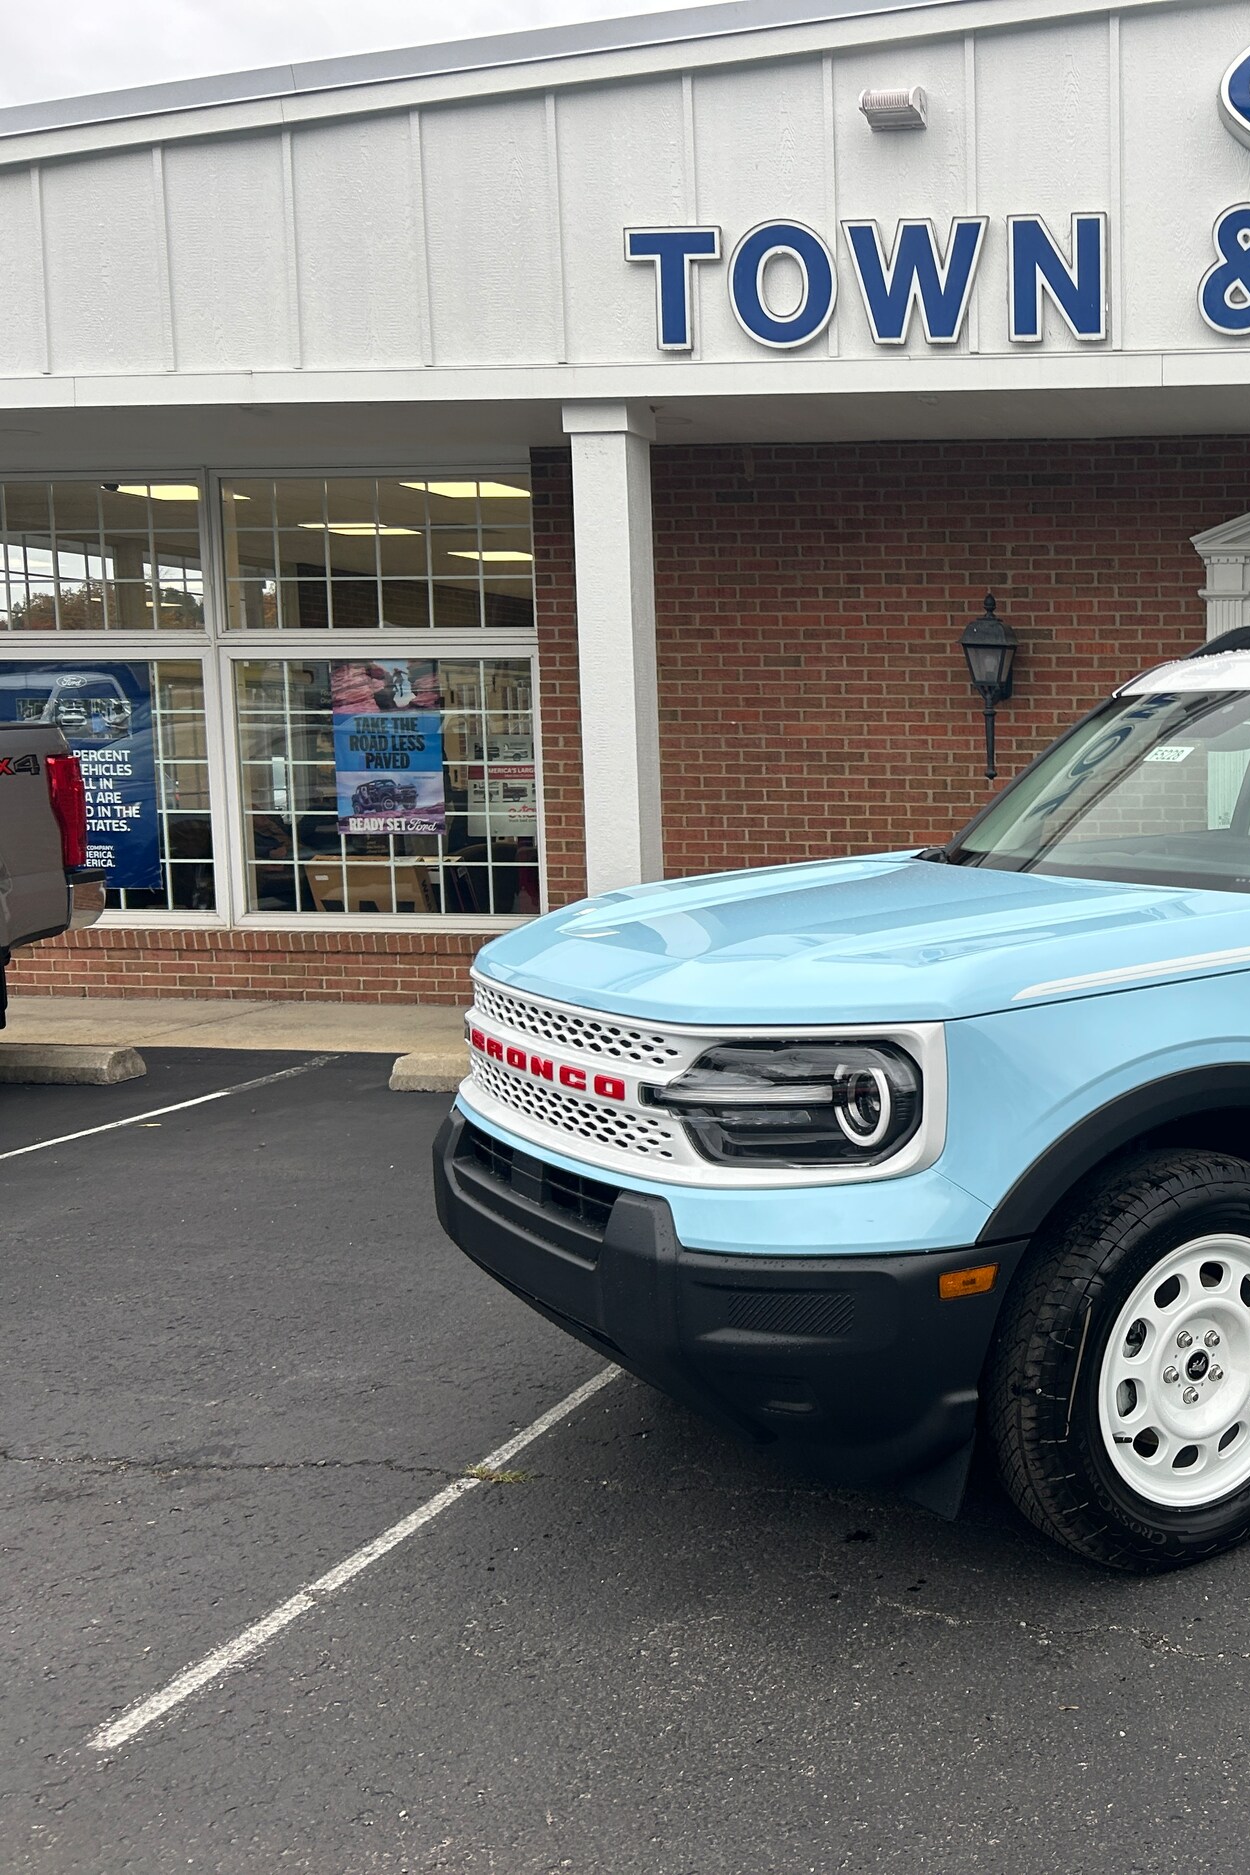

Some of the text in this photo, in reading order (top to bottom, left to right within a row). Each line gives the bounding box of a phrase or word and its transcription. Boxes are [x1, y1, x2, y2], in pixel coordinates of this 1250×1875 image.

[623, 211, 1108, 352] TOWN
[353, 717, 419, 734] TAKE THE
[349, 735, 426, 751] ROAD LESS
[72, 750, 130, 762] PERCENT
[365, 752, 410, 769] PAVED
[80, 764, 132, 776] EHICLES
[99, 778, 113, 790] IN
[96, 792, 122, 804] ARE
[97, 806, 111, 817] IN
[113, 806, 140, 818] THE
[349, 818, 438, 832] READY SET Ford
[86, 851, 116, 859] ERICA.
[84, 859, 116, 867] ERICA.
[472, 1028, 625, 1101] BRONCO
